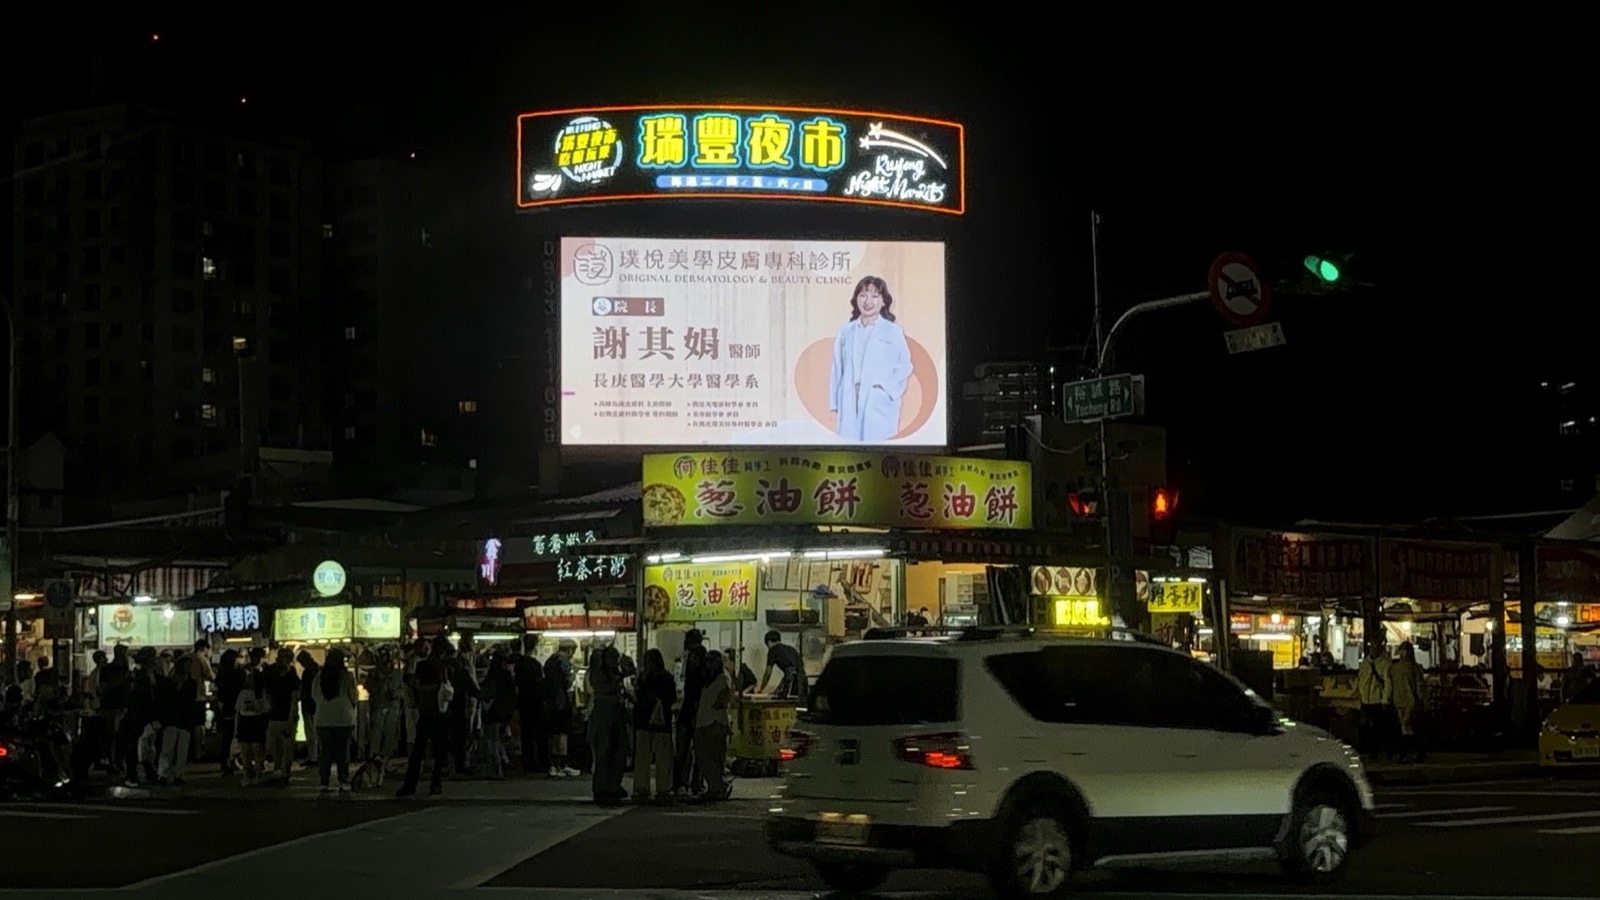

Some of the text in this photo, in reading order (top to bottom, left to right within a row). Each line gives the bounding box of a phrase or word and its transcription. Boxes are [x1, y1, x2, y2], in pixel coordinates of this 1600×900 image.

[640, 115, 844, 168] 瑞豐夜市
[844, 171, 890, 197] Night
[619, 249, 851, 271] 璞悅美學皮膚專科診所
[618, 274, 852, 285] ORIGINAL DERMATOLOGY & BEAUTY CLINIC
[592, 326, 761, 360] 謝其娟 醫師
[593, 372, 760, 389] 長庚醫學大學醫學系
[674, 456, 741, 479] 何佳佳
